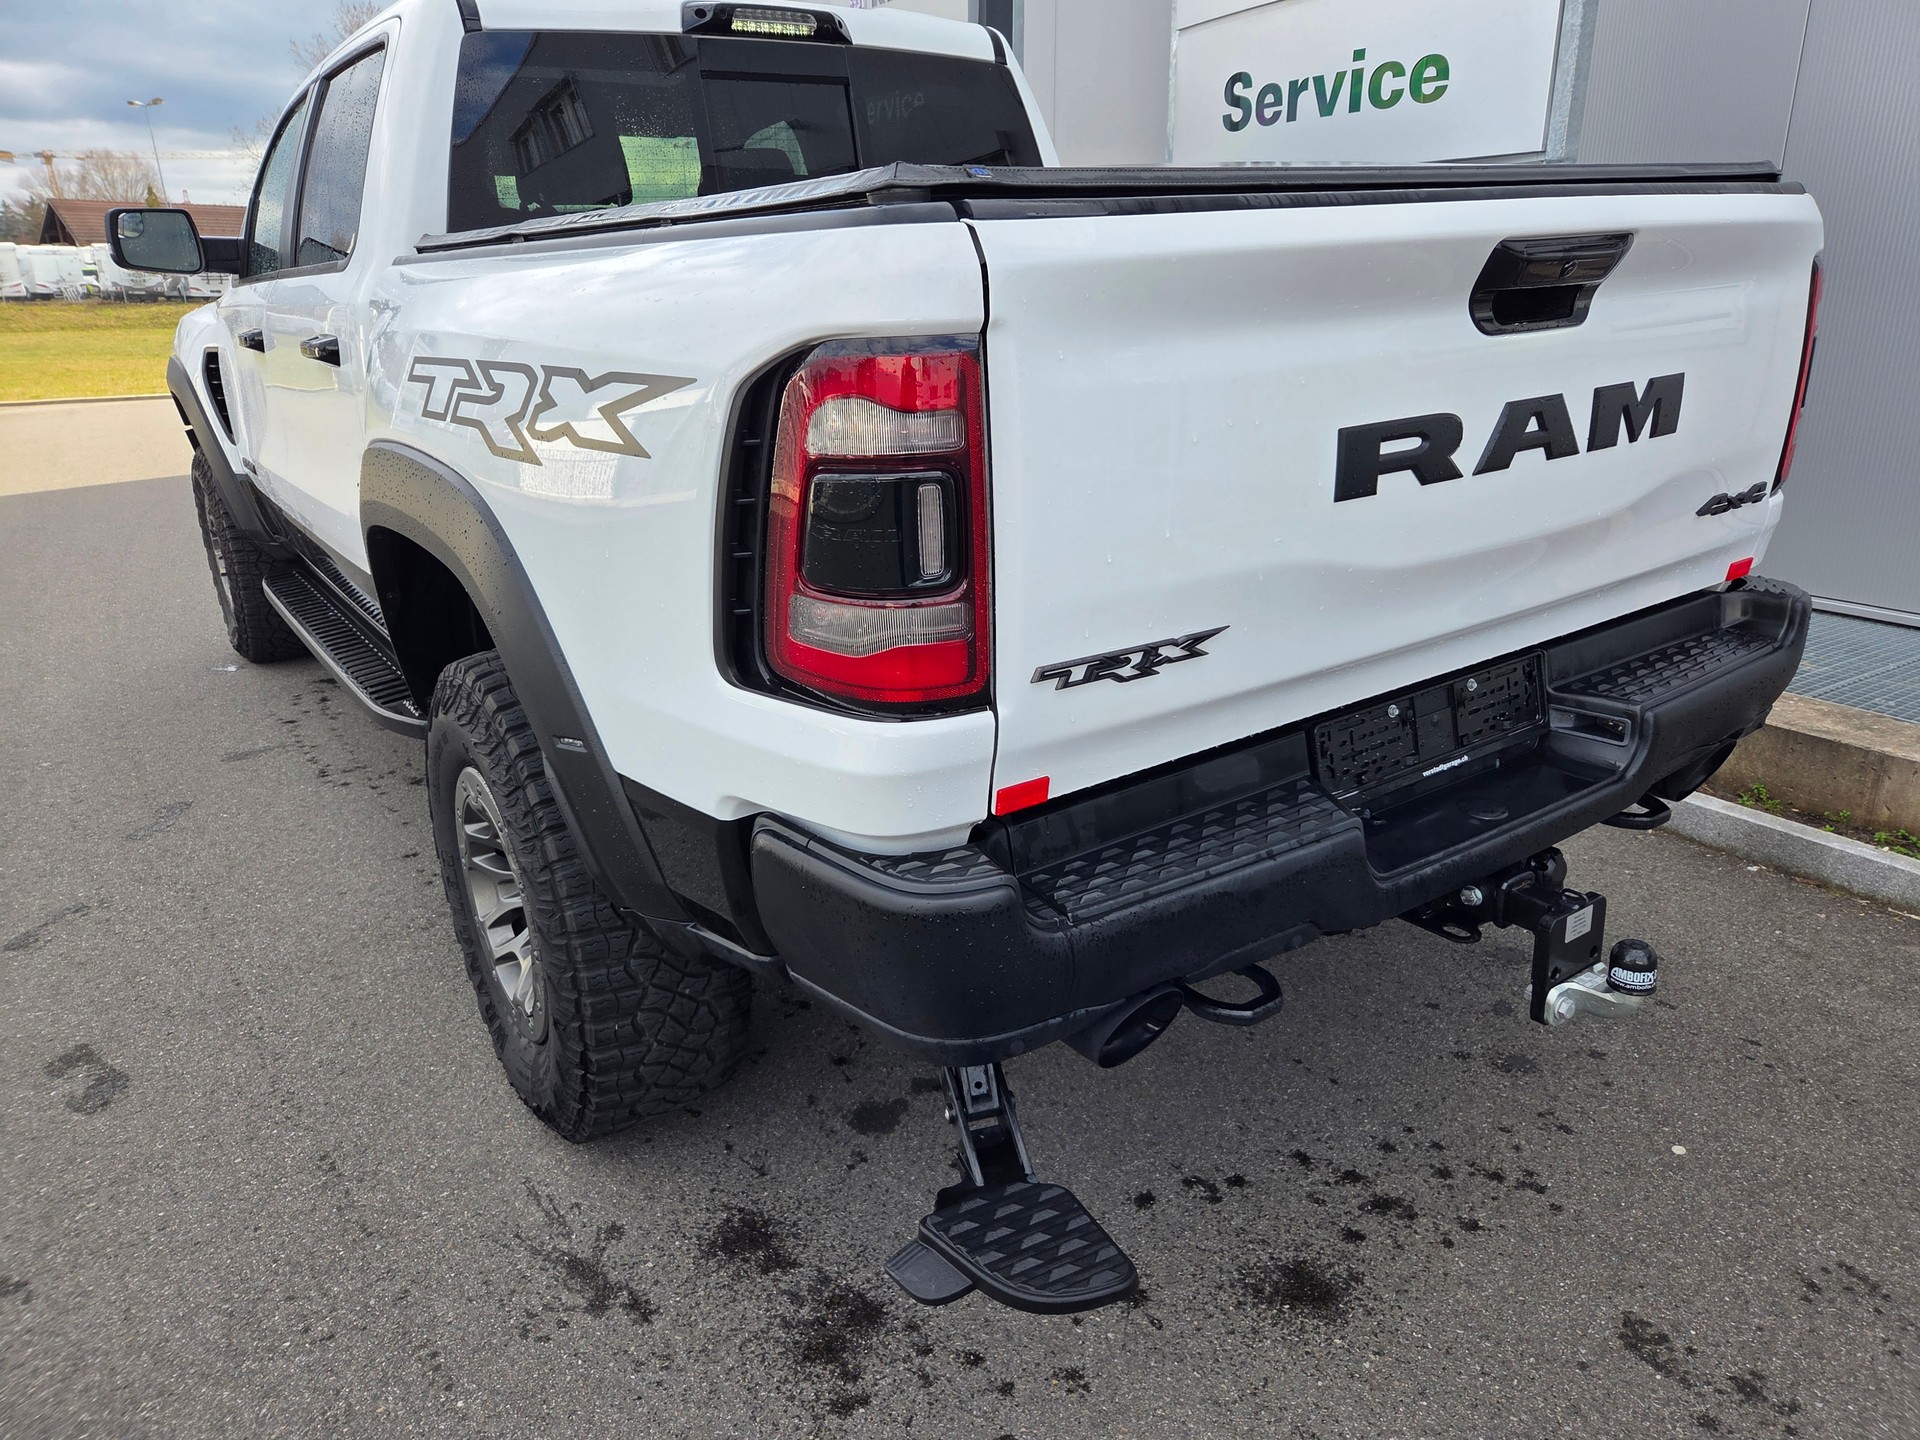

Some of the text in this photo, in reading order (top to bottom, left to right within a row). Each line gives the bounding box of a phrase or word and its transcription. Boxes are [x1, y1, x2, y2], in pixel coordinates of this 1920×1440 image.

[867, 91, 925, 125] ervice
[1222, 48, 1450, 132] Service
[407, 356, 698, 466] TRX
[1334, 372, 1685, 502] RAM
[1696, 481, 1768, 517] 4x4
[1030, 625, 1230, 690] TRX
